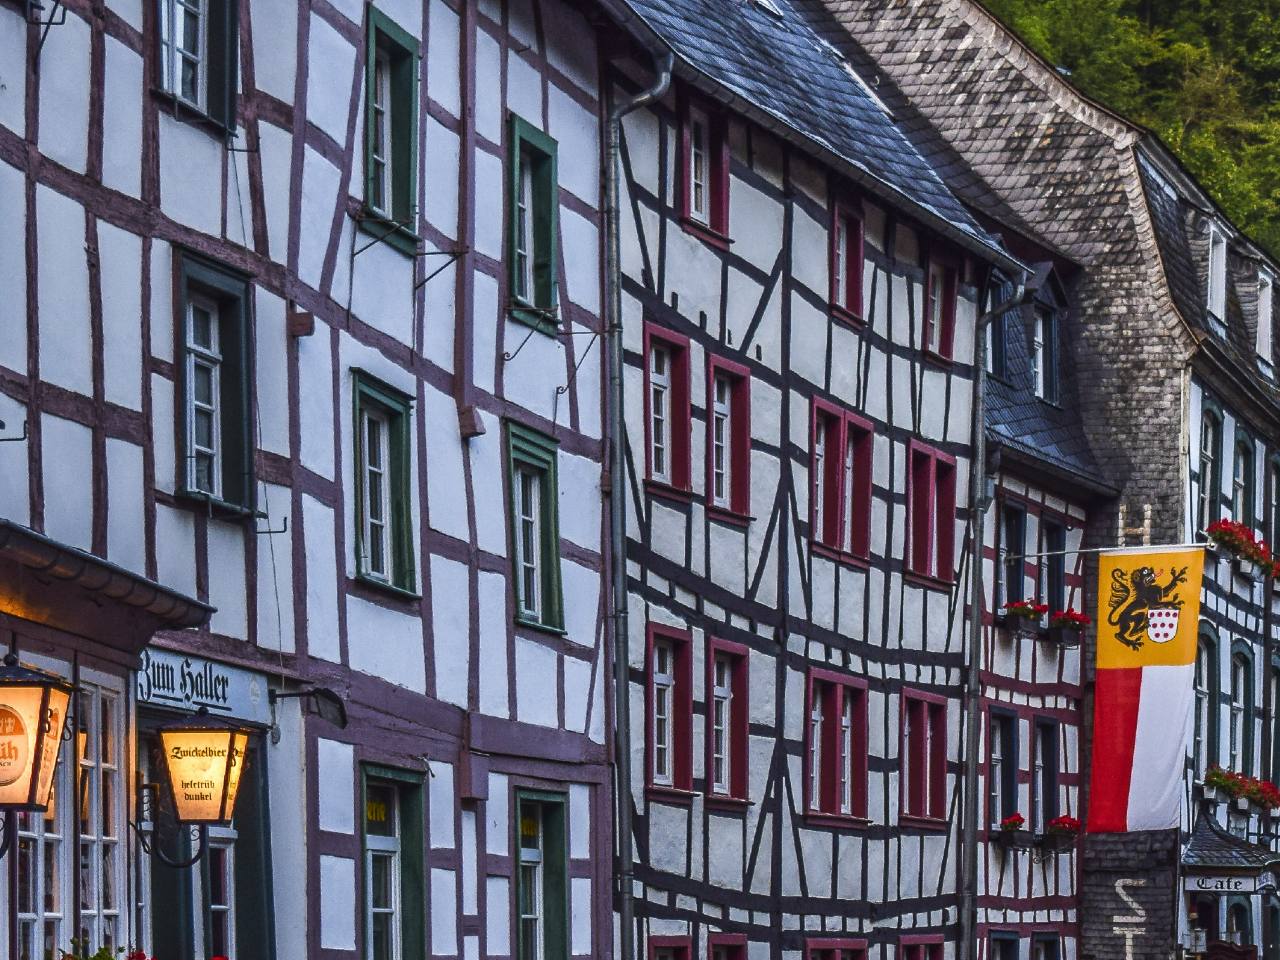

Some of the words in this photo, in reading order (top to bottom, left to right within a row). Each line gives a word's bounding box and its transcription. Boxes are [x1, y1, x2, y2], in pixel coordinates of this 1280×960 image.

[139, 649, 175, 702] Zum
[180, 658, 229, 703] Haller
[171, 747, 226, 759] Zwickelbier
[184, 792, 212, 801] dunkel
[1196, 877, 1243, 890] Cafe
